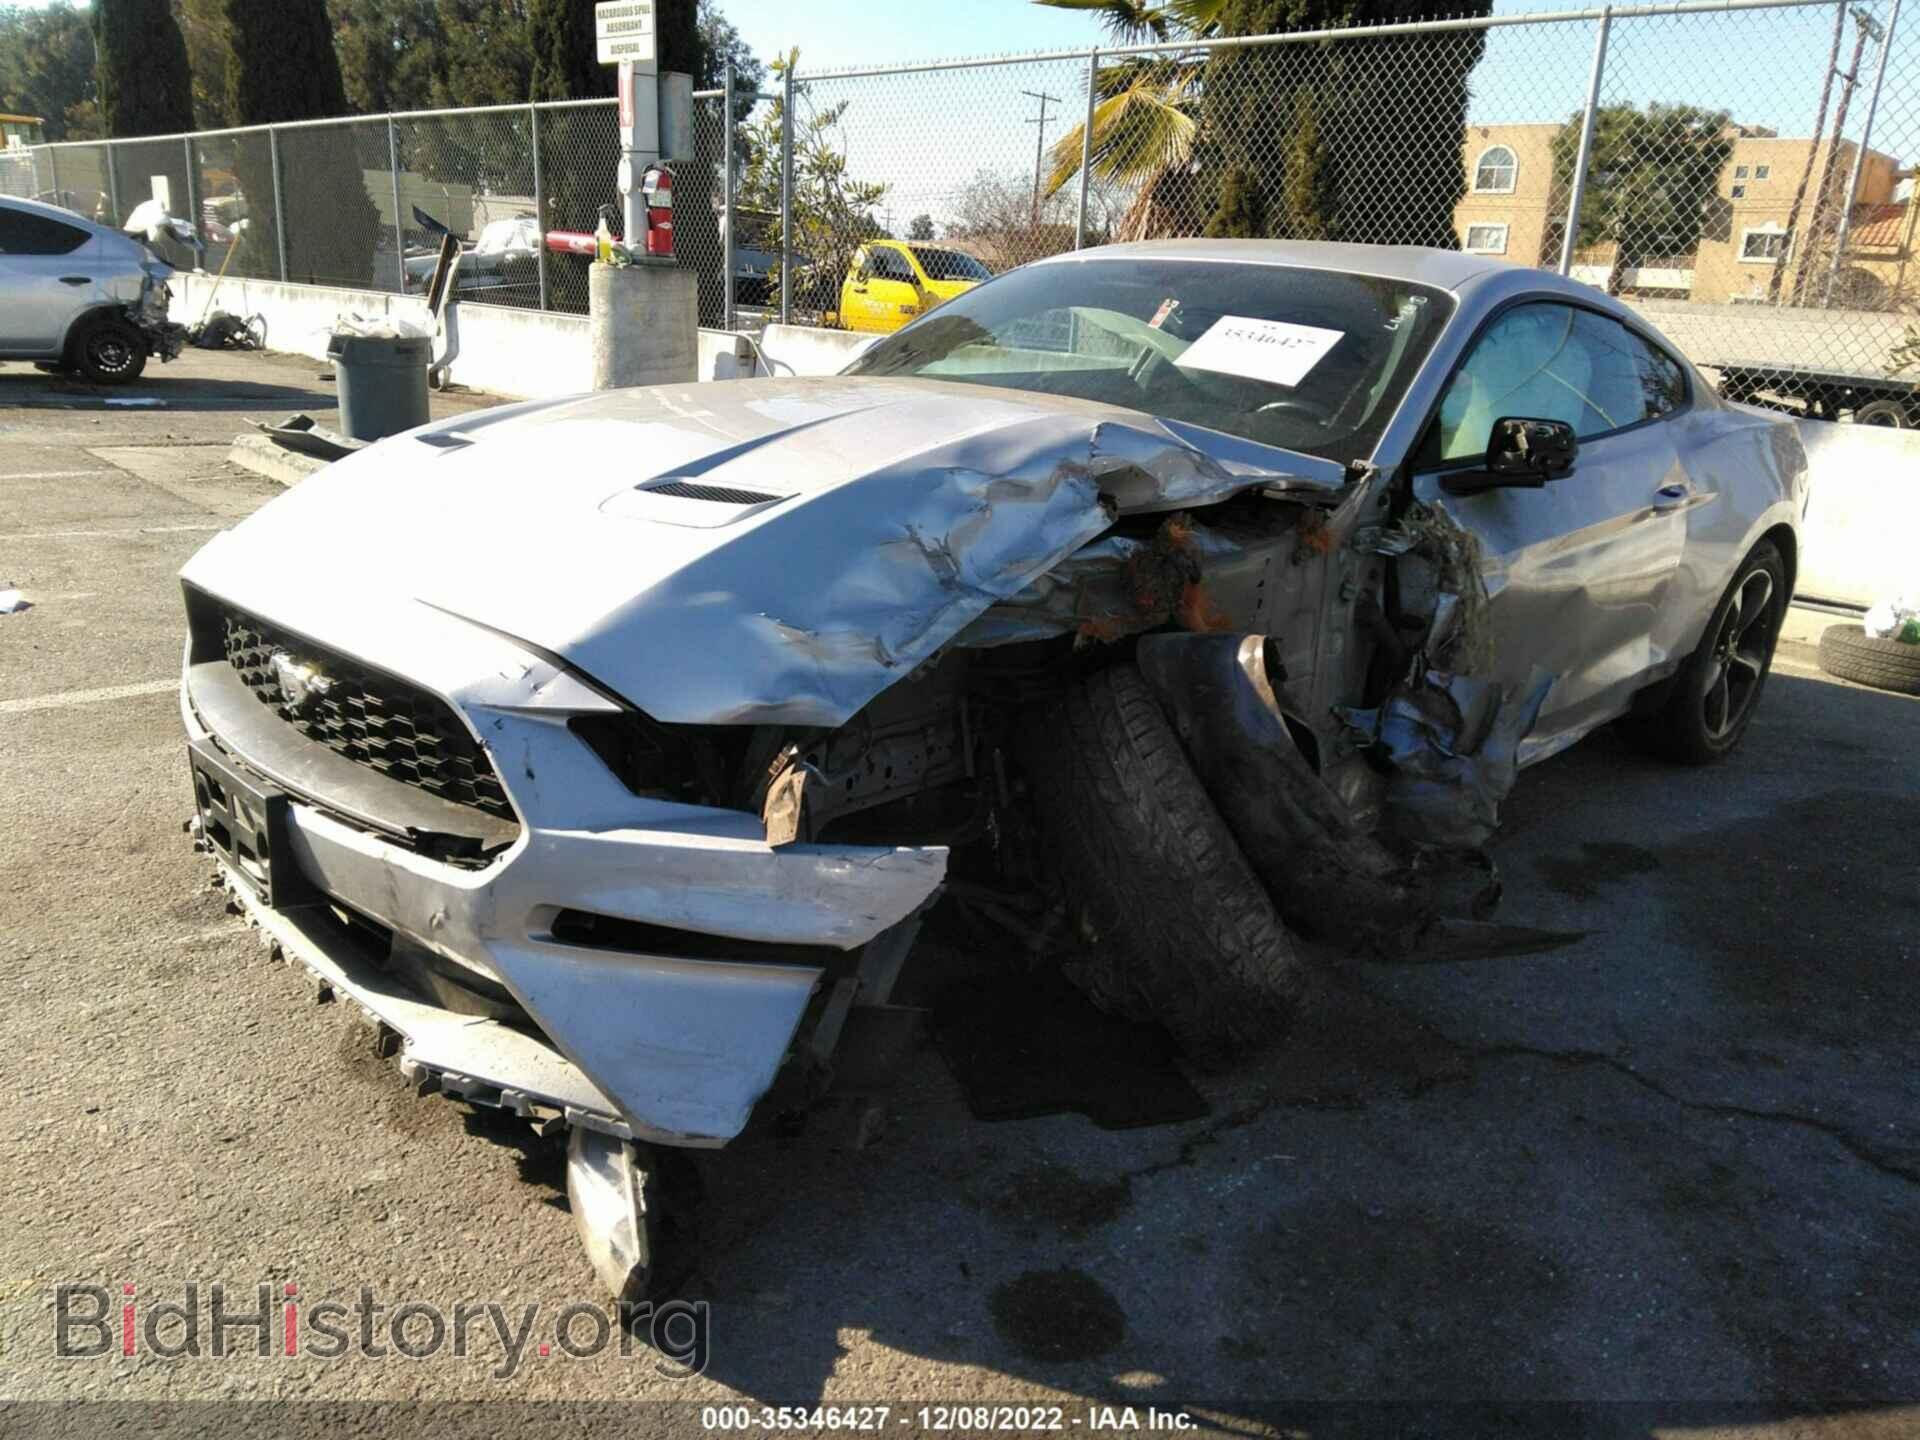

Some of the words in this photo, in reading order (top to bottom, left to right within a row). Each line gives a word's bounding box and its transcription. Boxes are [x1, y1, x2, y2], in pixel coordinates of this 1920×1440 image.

[598, 6, 633, 18] HAZARDOUS
[634, 4, 651, 16] SPILL
[610, 43, 640, 55] DISPOSAL
